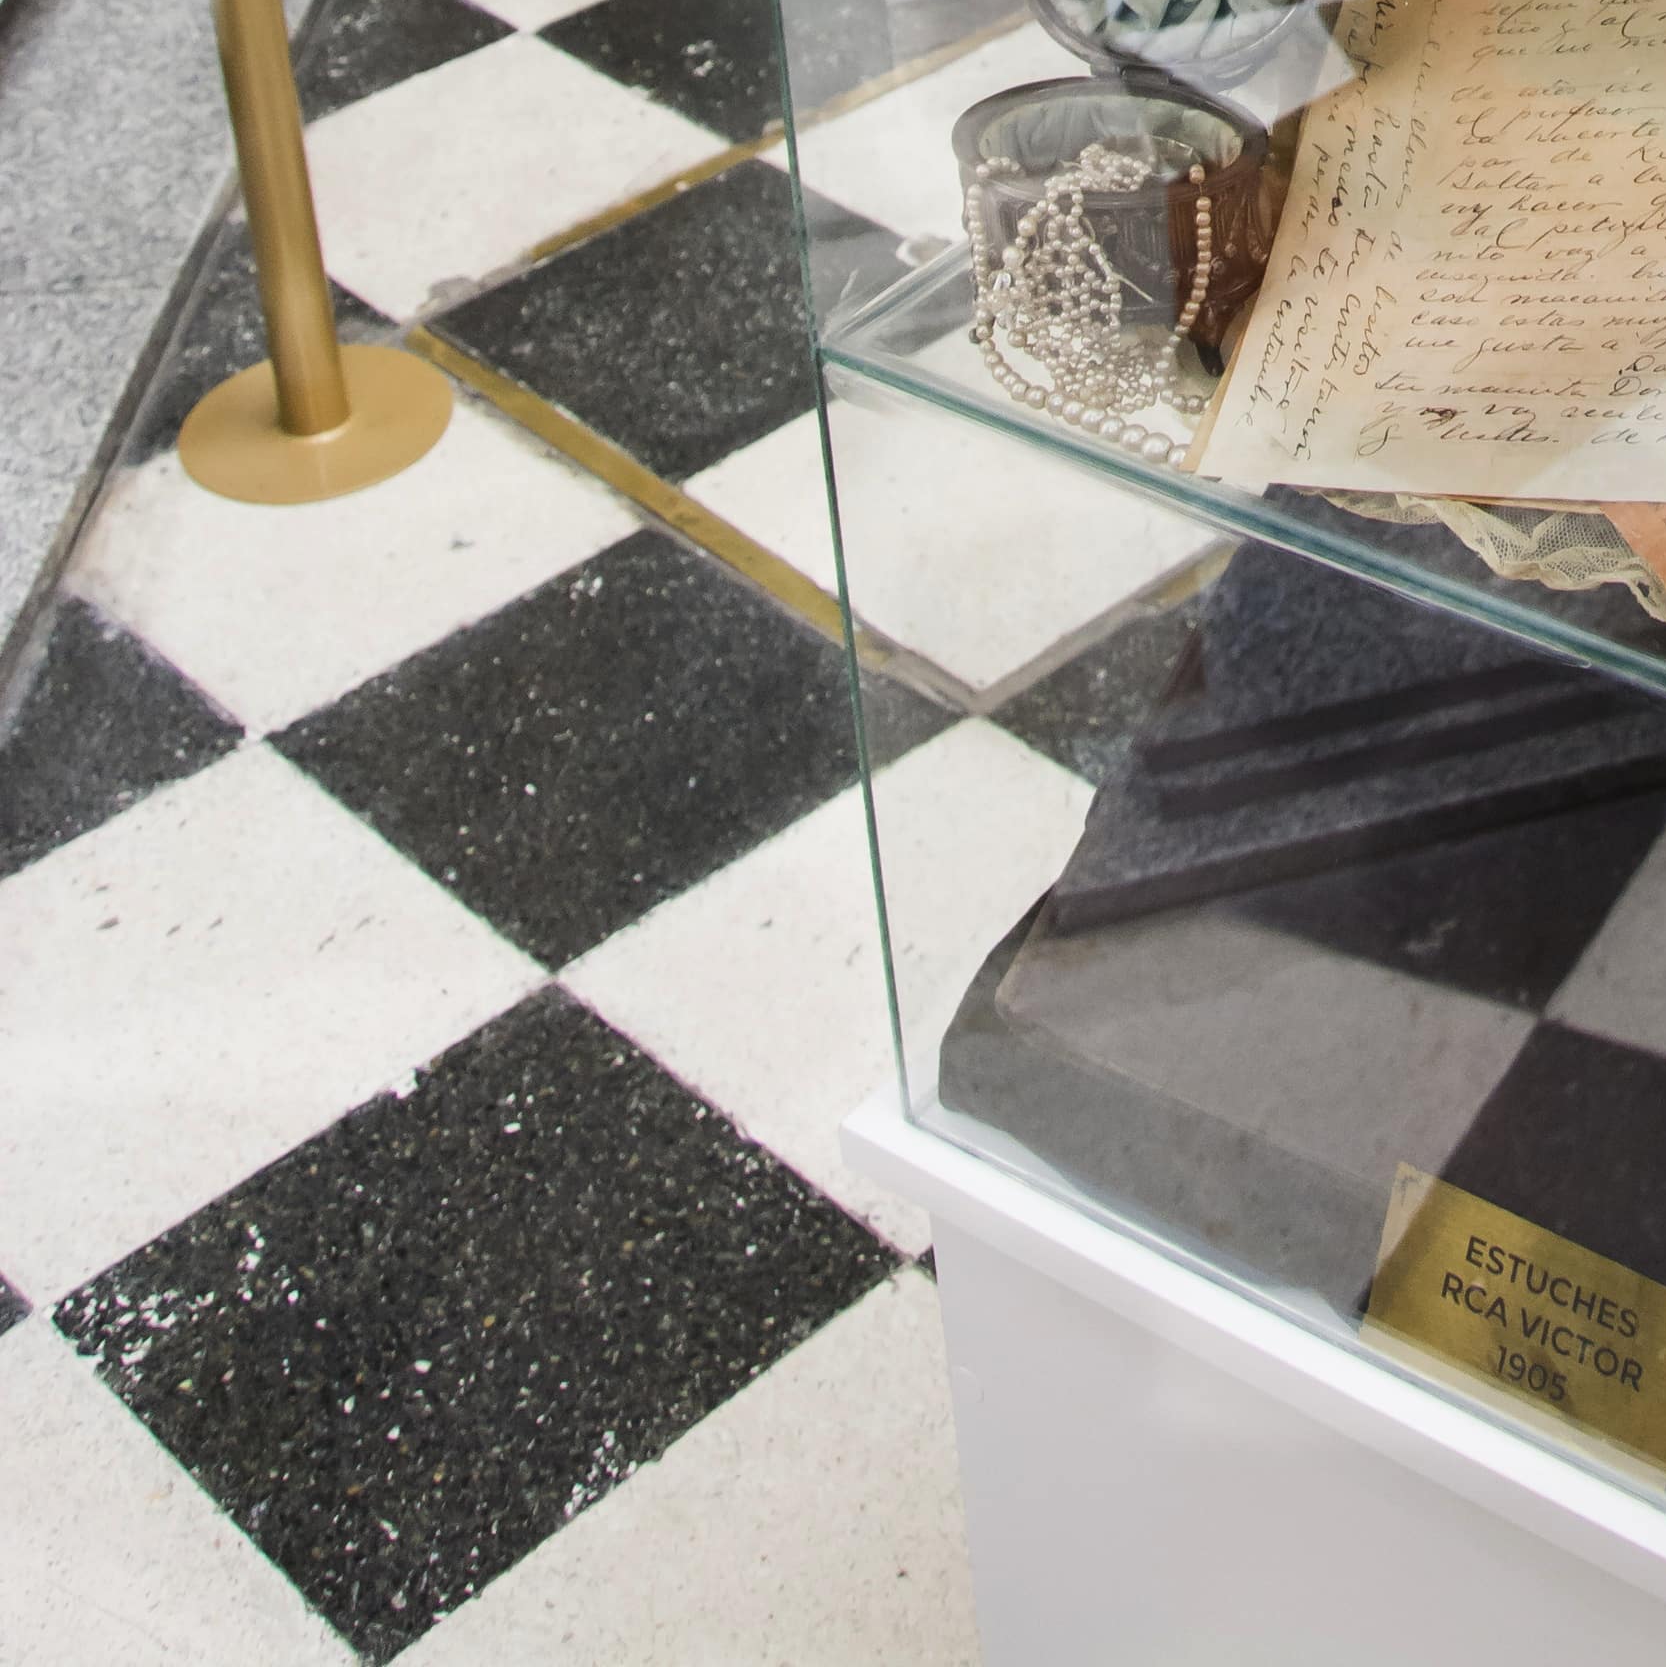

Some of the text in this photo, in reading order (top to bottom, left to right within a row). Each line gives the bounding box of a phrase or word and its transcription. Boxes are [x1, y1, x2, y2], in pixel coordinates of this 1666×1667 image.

[1440, 1271, 1645, 1393] RCA VICTOR
[1464, 1235, 1639, 1339] ESTUCHES
[1496, 1345, 1568, 1402] 1905
